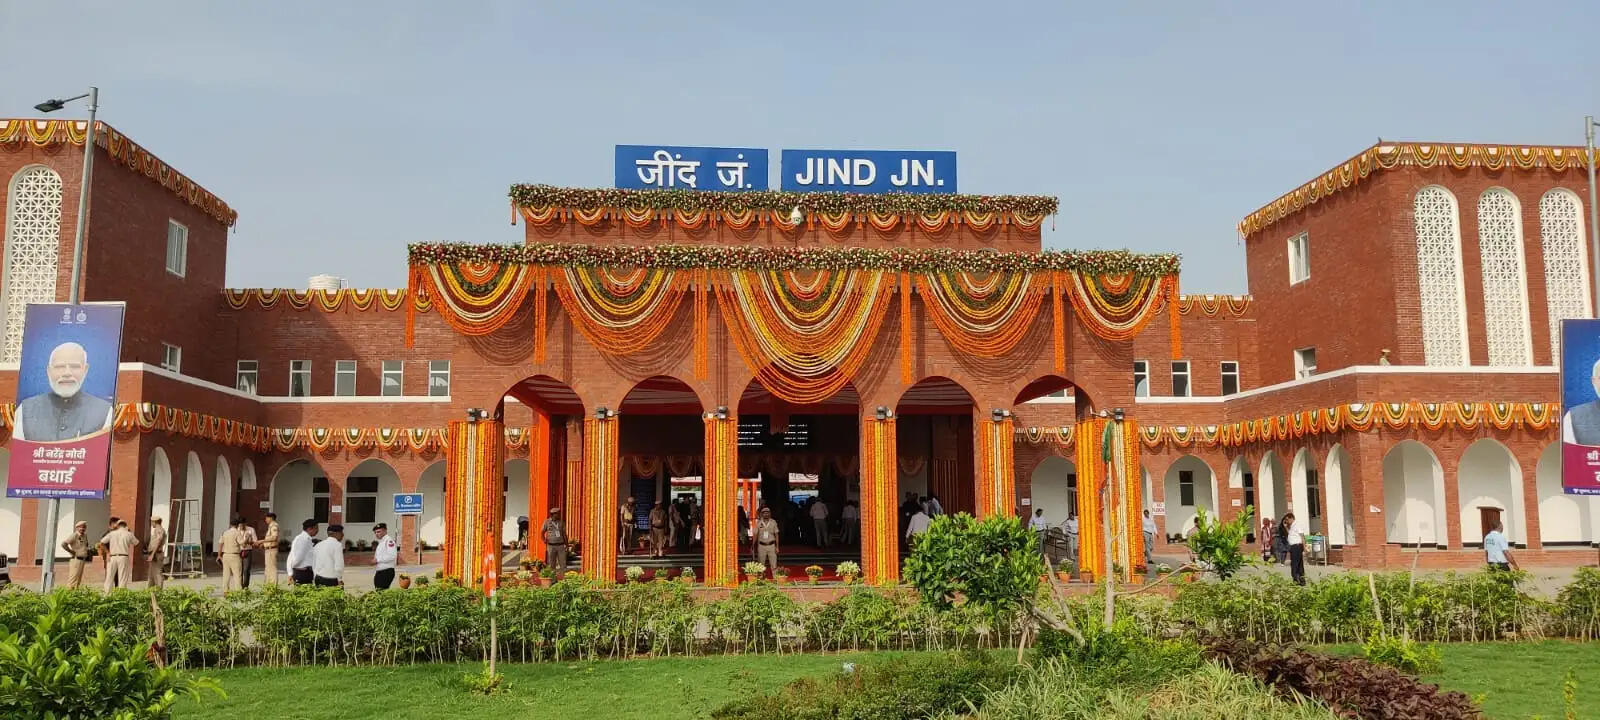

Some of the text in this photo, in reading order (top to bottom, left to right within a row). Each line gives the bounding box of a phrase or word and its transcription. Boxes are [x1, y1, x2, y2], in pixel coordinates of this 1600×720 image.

[635, 150, 752, 189] जींद जं.
[795, 157, 945, 187] JIND JN.
[33, 447, 44, 458] श्री
[65, 447, 86, 459] मोदी
[39, 466, 76, 483] बधाई
